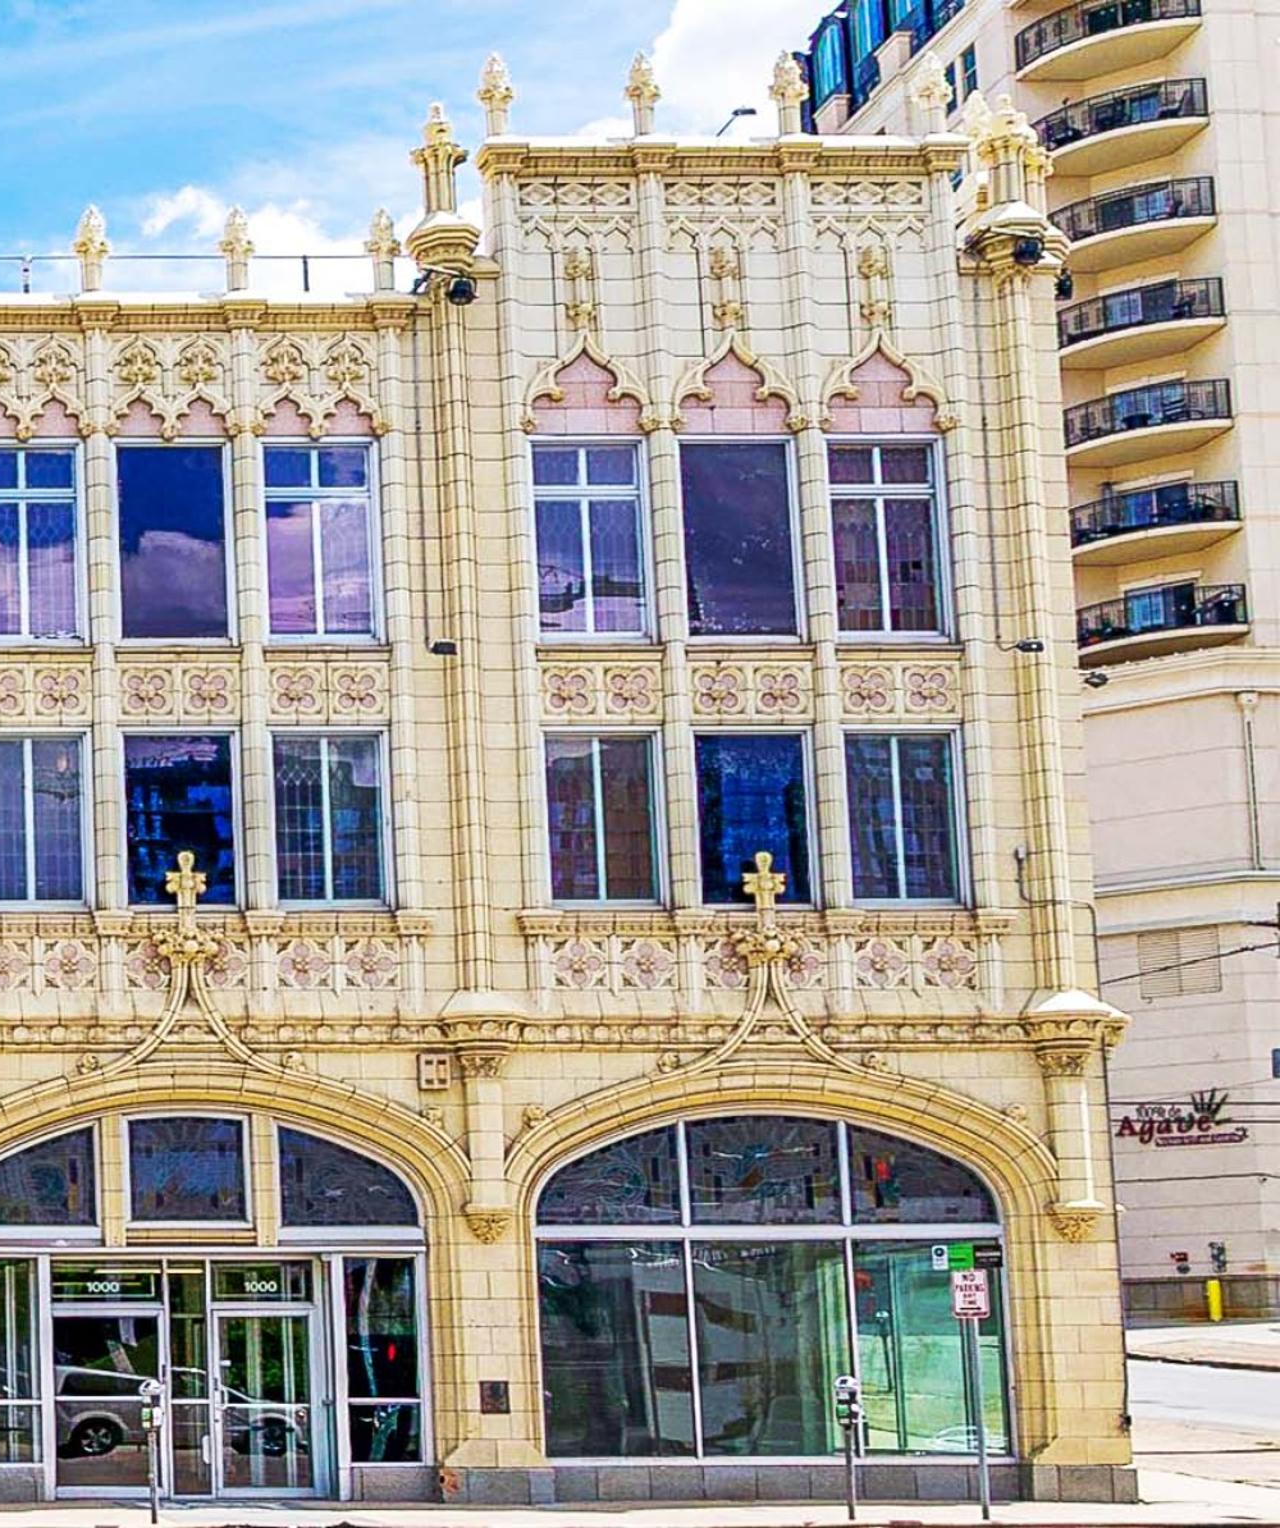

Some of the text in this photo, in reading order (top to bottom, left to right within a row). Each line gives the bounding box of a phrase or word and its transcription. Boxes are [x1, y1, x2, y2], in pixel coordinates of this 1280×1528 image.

[1115, 1113, 1212, 1144] Agave
[961, 1273, 976, 1282] NO
[86, 1282, 120, 1292] 1000
[244, 1281, 277, 1292] 1000
